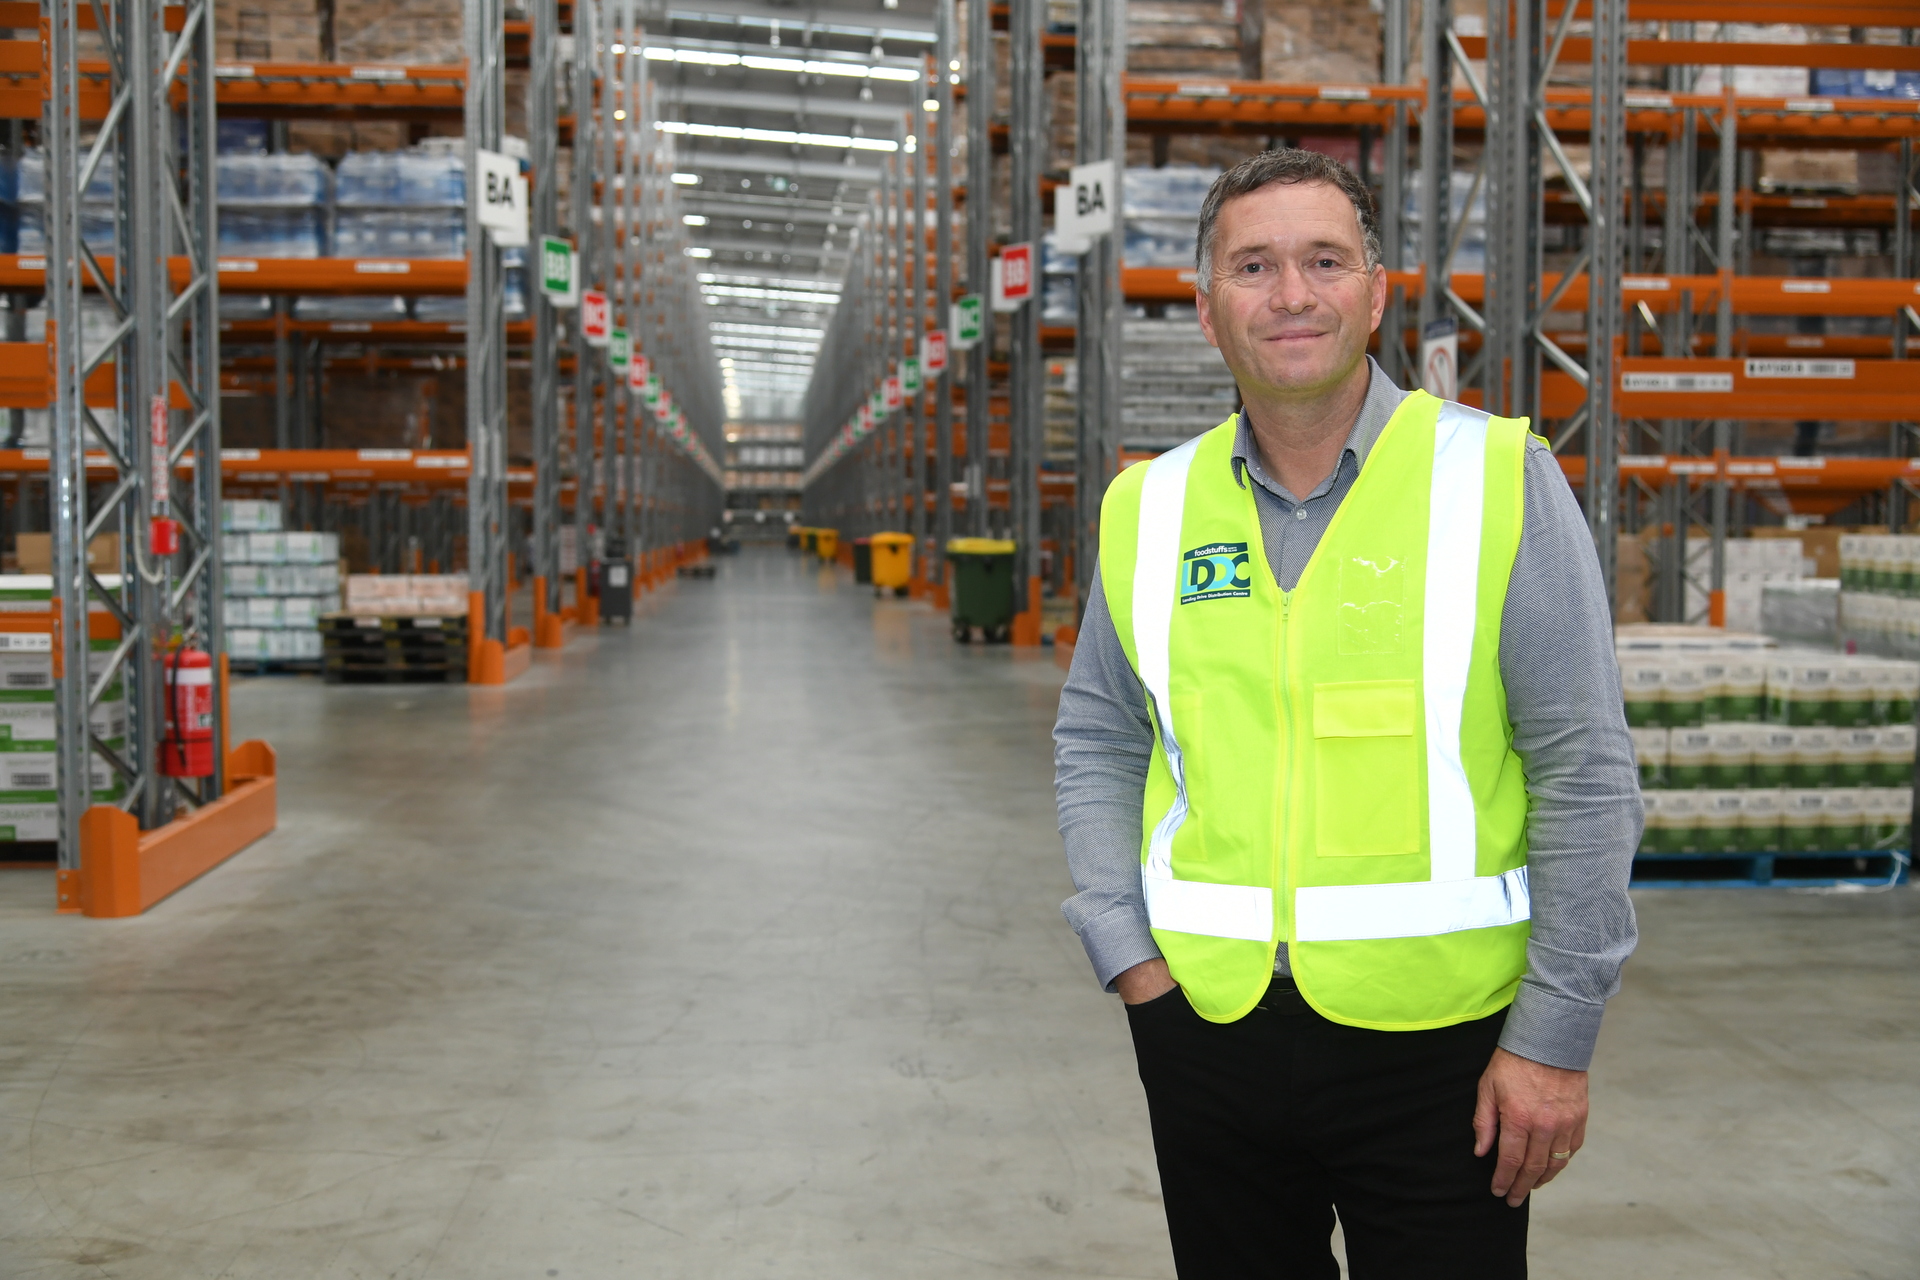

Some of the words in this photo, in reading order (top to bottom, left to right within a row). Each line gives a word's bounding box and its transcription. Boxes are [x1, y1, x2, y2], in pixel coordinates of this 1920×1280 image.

[486, 168, 515, 207] BA
[1076, 180, 1105, 216] BA
[1194, 545, 1228, 557] foodstuffs
